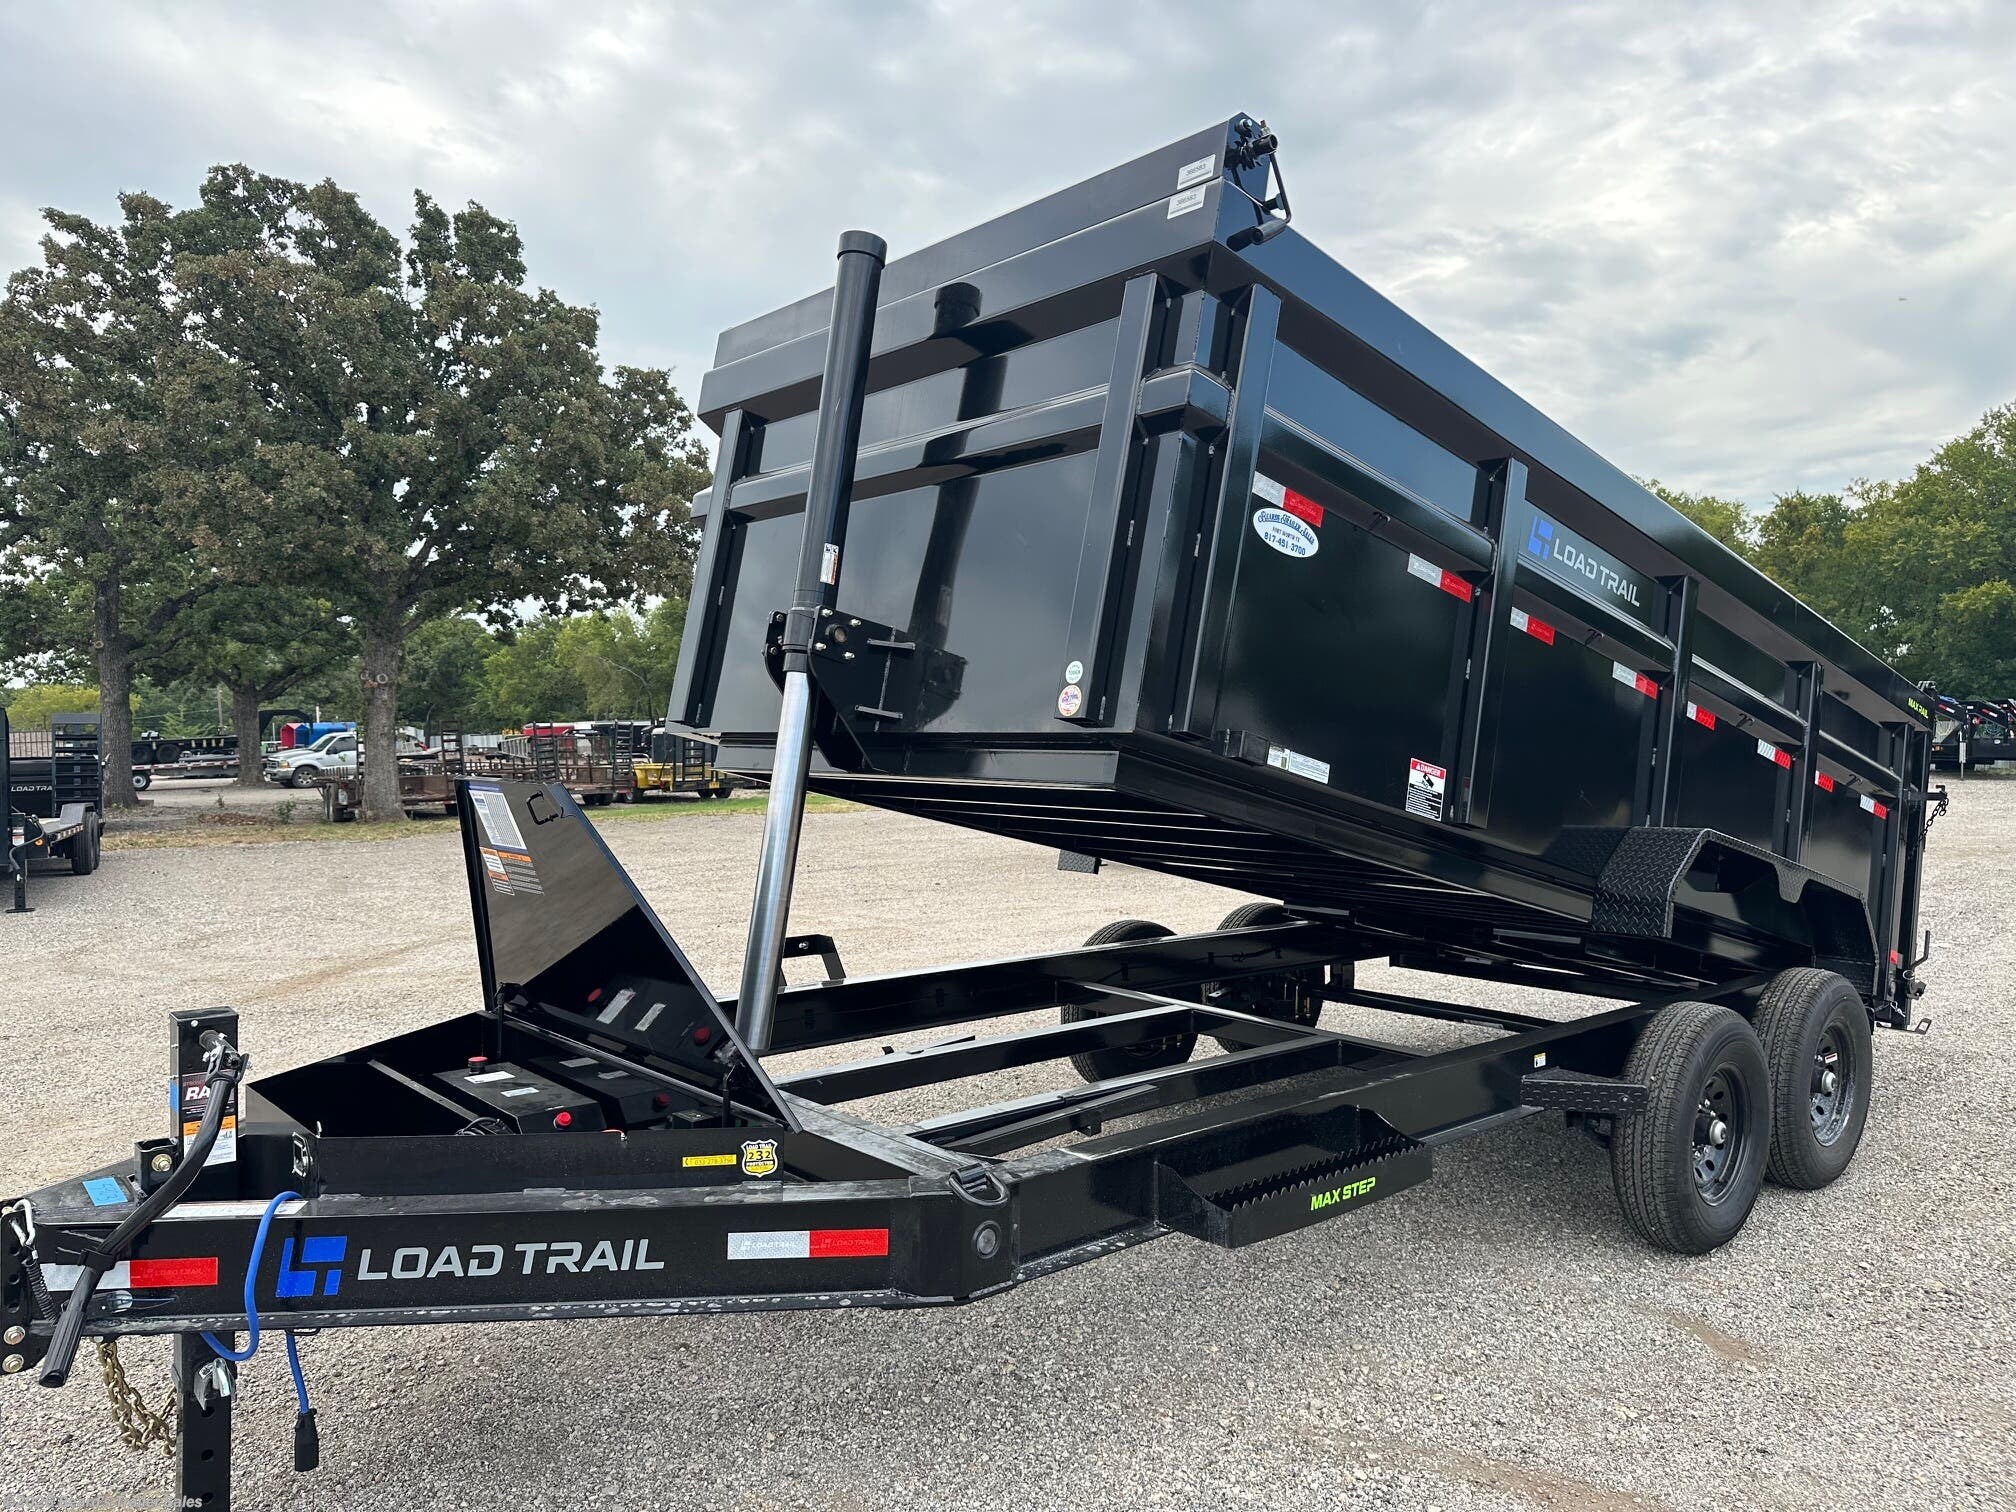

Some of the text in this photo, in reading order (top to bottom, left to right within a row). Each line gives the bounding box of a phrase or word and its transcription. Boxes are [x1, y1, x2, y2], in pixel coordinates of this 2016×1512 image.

[1264, 532, 1306, 556] 817-451-3700
[1553, 538, 1640, 607] LOAD TRAIL
[1908, 697, 1919, 712] MAX
[1420, 763, 1441, 777] DANGER
[185, 1085, 211, 1101] RA
[1311, 1176, 1376, 1211] MAX STEP
[357, 1238, 665, 1281] LOAD TRAIL
